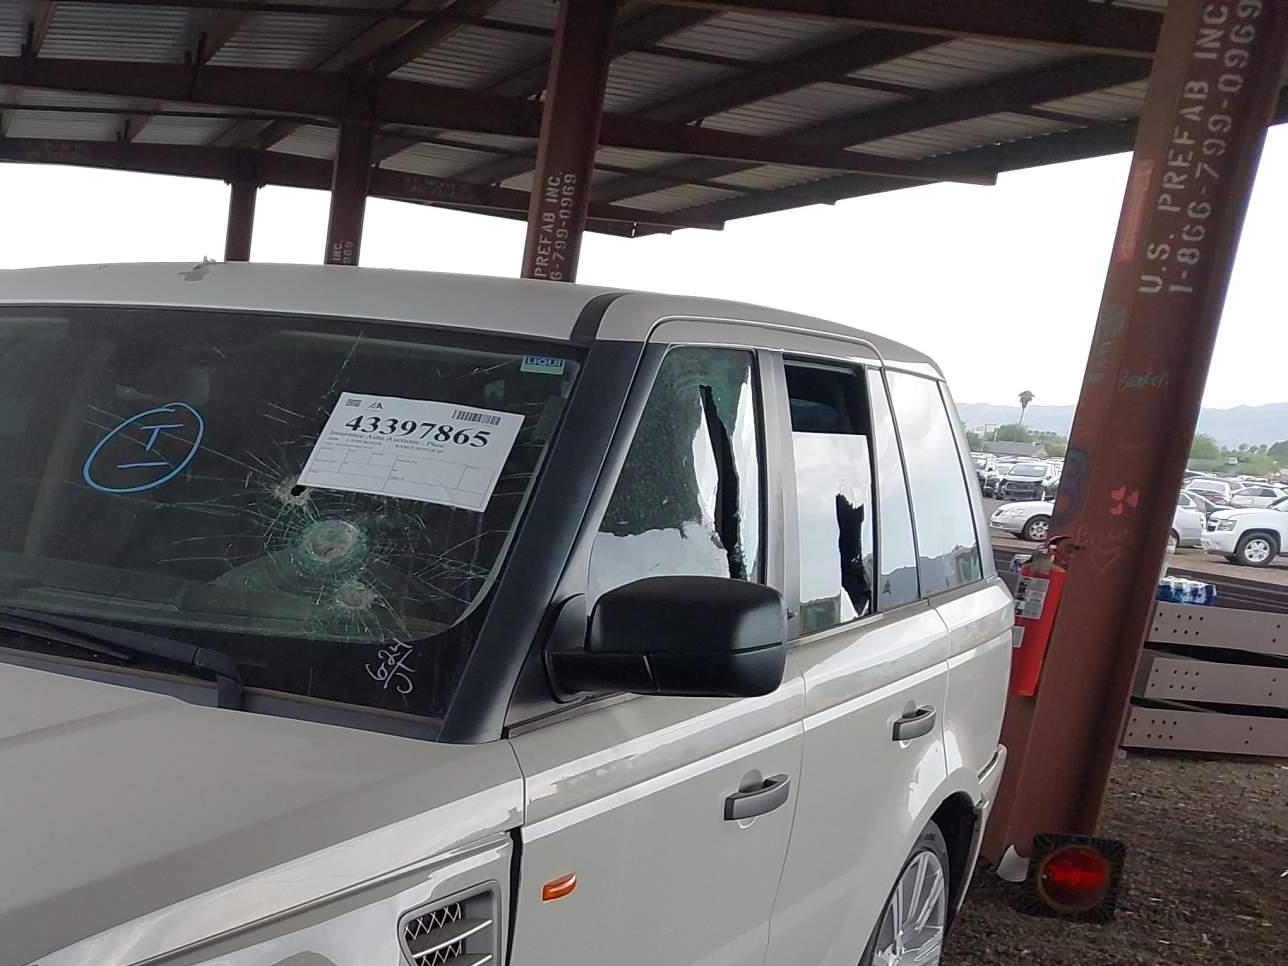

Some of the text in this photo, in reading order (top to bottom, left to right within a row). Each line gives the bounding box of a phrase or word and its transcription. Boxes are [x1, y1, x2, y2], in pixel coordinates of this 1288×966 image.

[1157, 79, 1210, 213] PREFAB
[1169, 0, 1263, 293] 1-866-799-0969
[534, 211, 556, 277] PREFAB
[329, 430, 365, 440] Insurance
[366, 433, 385, 441] Auto
[344, 414, 492, 448] 43397865
